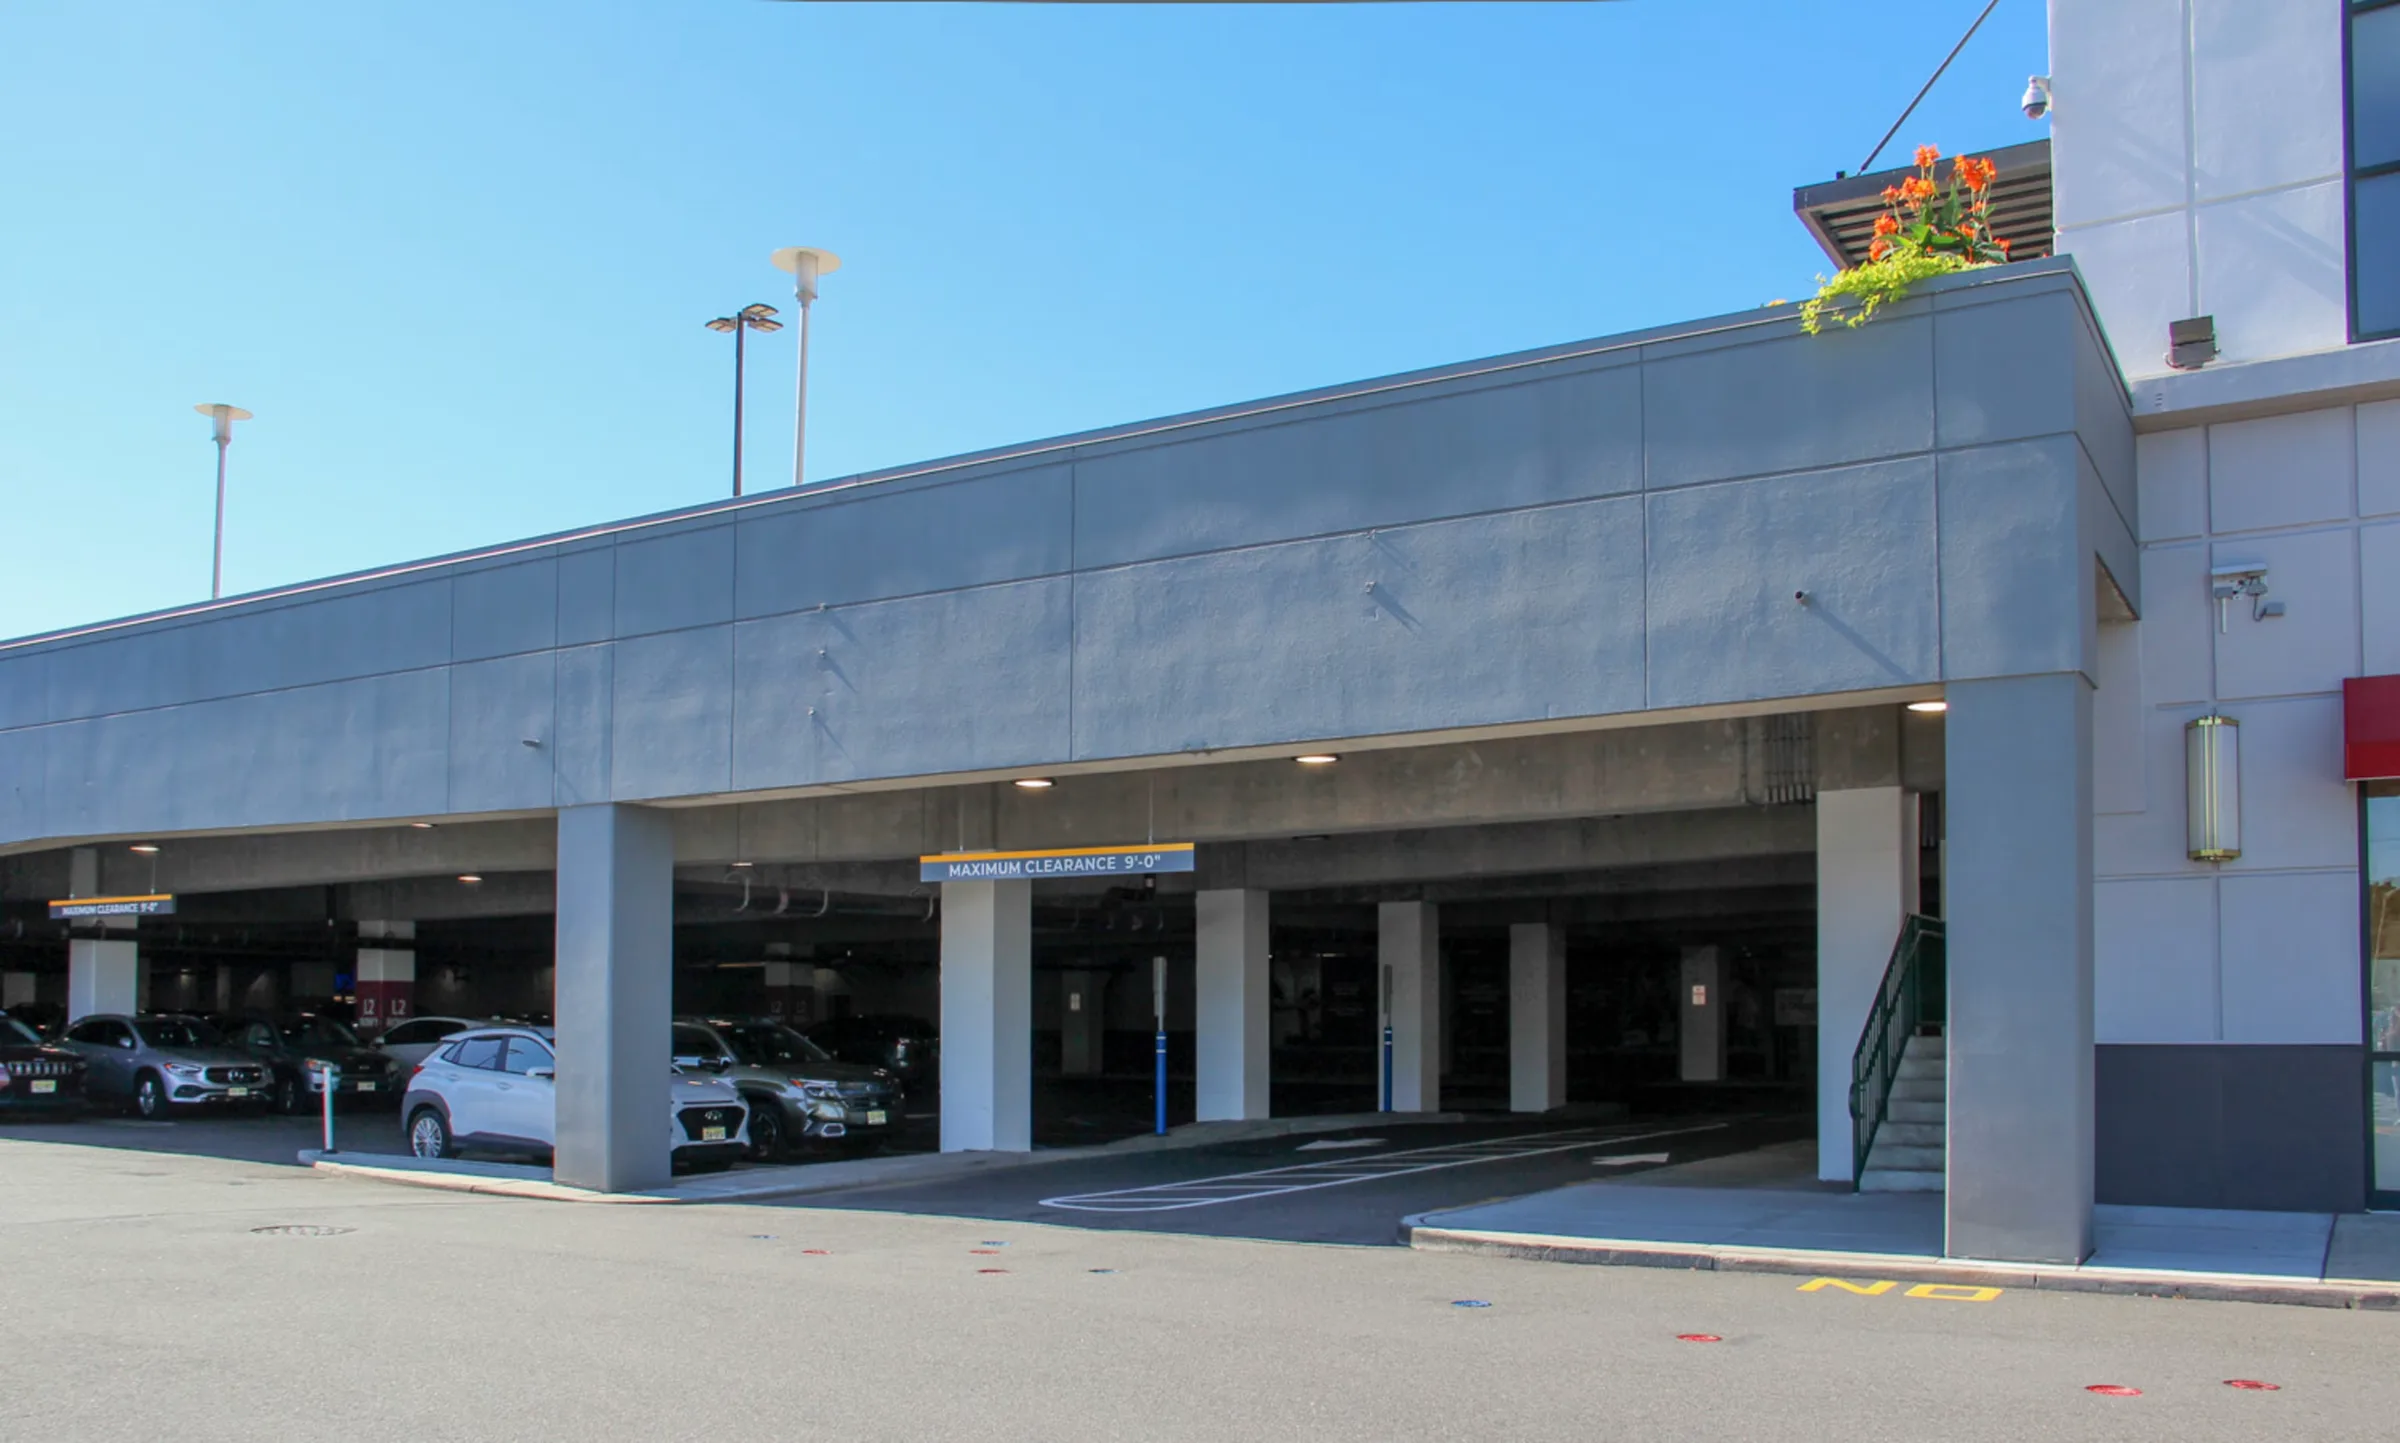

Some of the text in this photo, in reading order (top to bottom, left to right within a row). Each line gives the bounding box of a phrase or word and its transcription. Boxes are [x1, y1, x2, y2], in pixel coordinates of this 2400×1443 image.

[949, 854, 1161, 877] MAXIMUM CLEARANCE 9'-0"
[62, 906, 96, 916] MAXIMUM
[97, 903, 138, 914] CLEARANCE
[363, 999, 375, 1015] L2
[391, 999, 406, 1015] L2
[1796, 1277, 2004, 1302] NO
